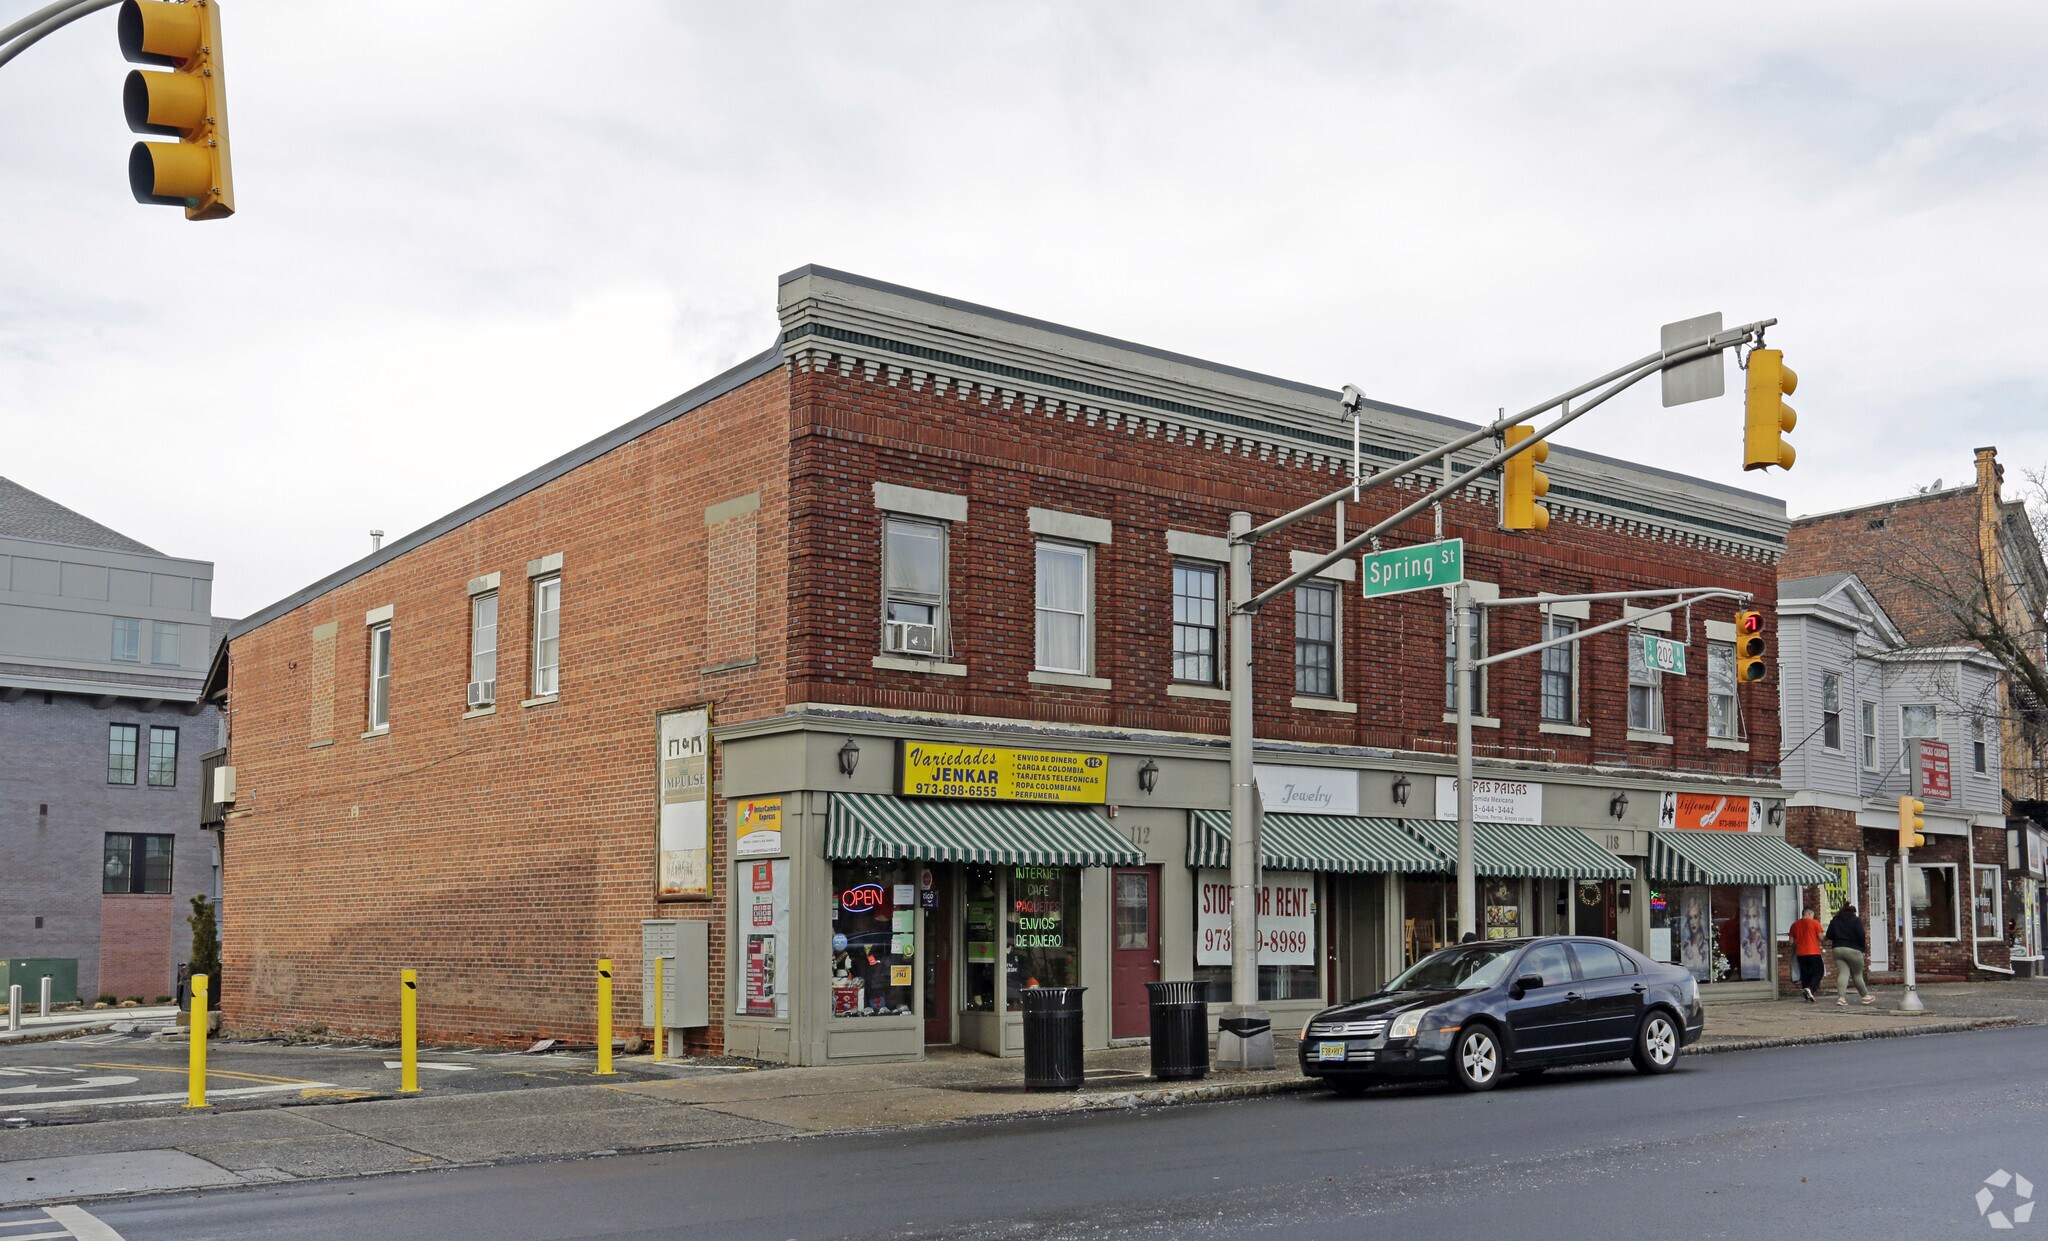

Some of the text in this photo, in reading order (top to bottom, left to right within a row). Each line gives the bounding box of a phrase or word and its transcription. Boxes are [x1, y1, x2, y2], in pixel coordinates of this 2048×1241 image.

[1370, 549, 1455, 587] Spring St
[1648, 641, 1653, 651] S
[1658, 646, 1673, 663] 202
[910, 747, 998, 768] Variedades
[1017, 754, 1078, 765] ENVIO DE DINERO
[1086, 759, 1101, 767] 112
[1017, 763, 1041, 772] CARGA
[1048, 765, 1084, 774] COLOMBIA
[664, 773, 705, 789] IMPULSE
[932, 767, 998, 784] JENKAR
[1016, 773, 1099, 784] TARJETAS TELEFONICAS
[916, 783, 997, 797] 973-898-6555
[1016, 781, 1082, 792] ROPA COLOMBIANA
[1453, 780, 1527, 795] APAS PAISAS
[1015, 791, 1060, 800] PERFUMERIA
[1282, 783, 1333, 807] Jewelry
[754, 804, 780, 814] InterCambio
[1474, 805, 1514, 814] 3-644-3442
[1676, 797, 1747, 815] Different Salon
[759, 813, 776, 822] Express
[1131, 826, 1151, 844] 112
[1605, 834, 1619, 849] 118
[1016, 867, 1061, 879] INTERNET
[922, 891, 934, 900] tigo
[1027, 884, 1049, 896] CAFE
[842, 889, 883, 907] OPEN
[1276, 887, 1308, 917] RENT
[1016, 901, 1060, 913] PAQUETES
[1020, 917, 1055, 930] ENVIOS
[1016, 934, 1061, 947] DE DINERO
